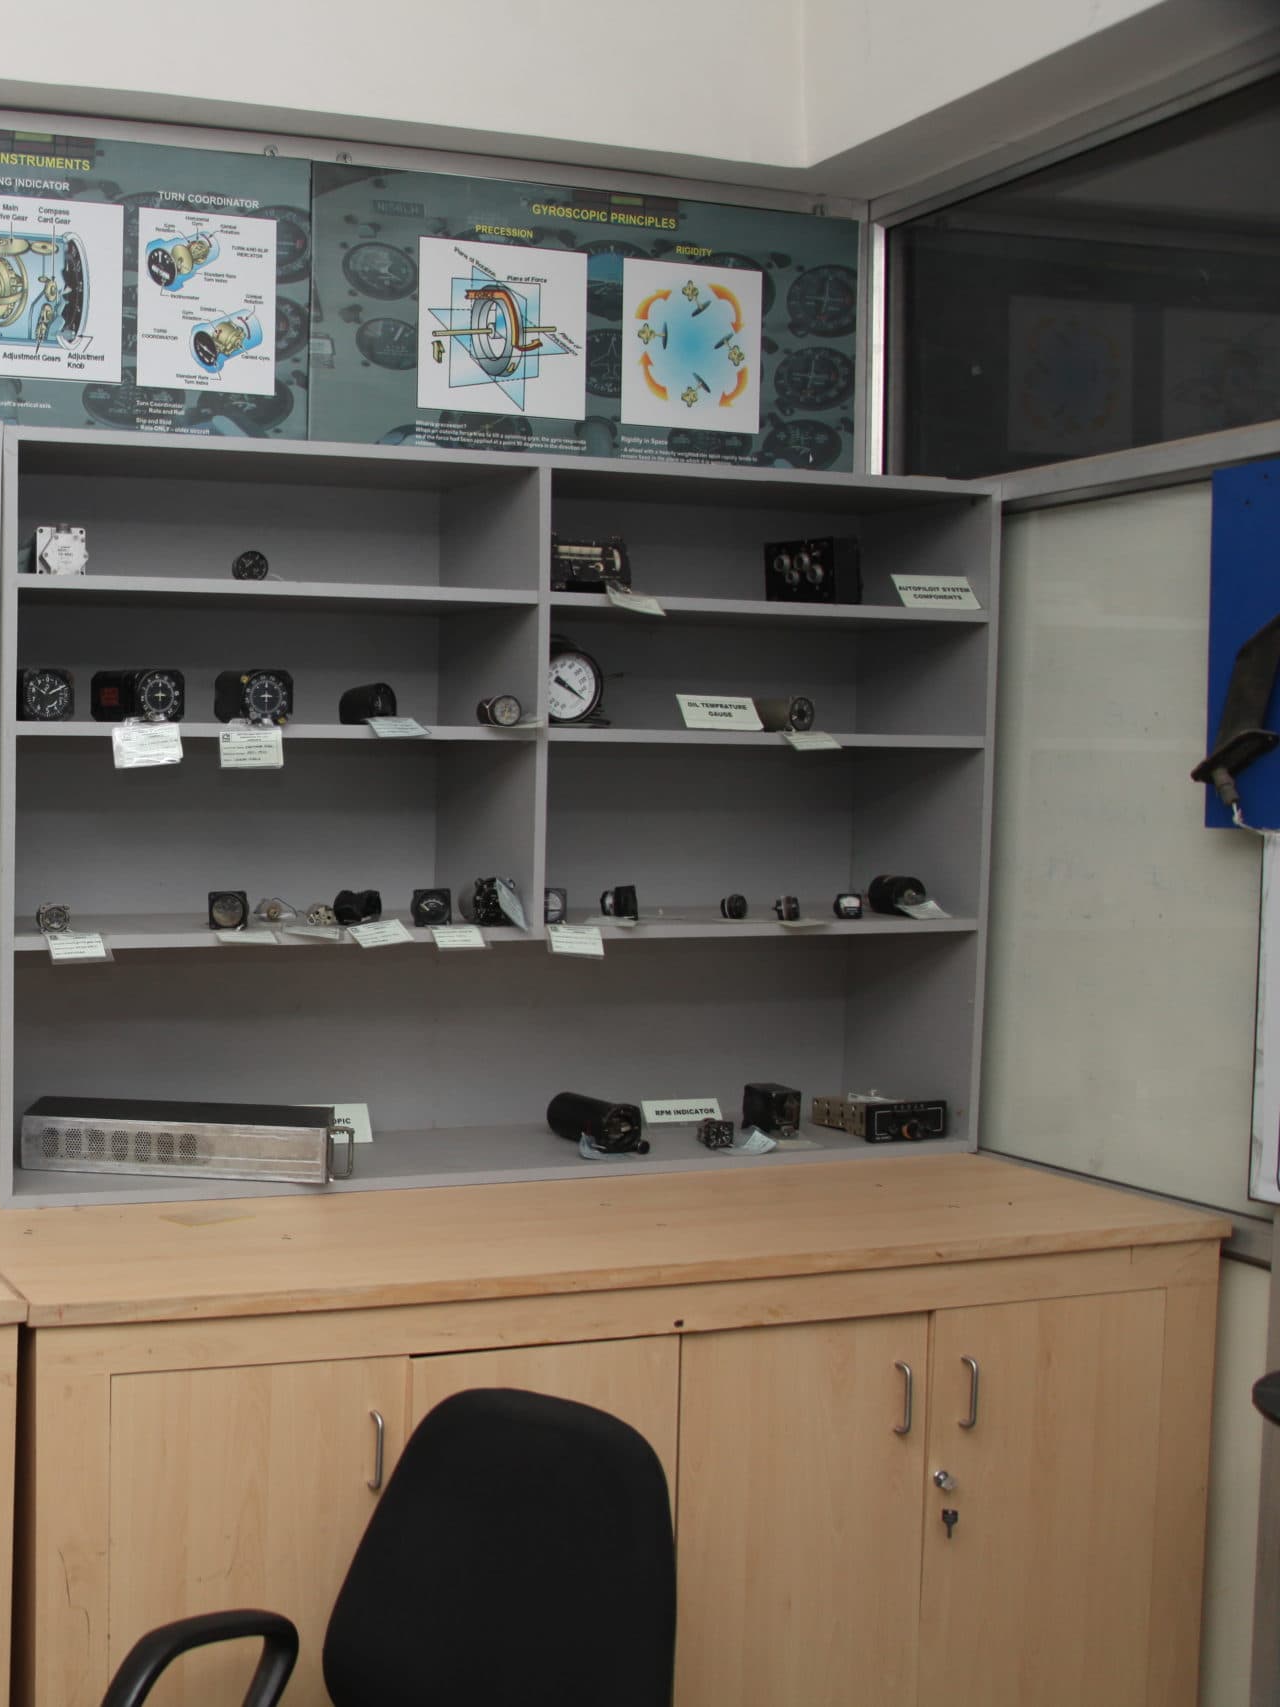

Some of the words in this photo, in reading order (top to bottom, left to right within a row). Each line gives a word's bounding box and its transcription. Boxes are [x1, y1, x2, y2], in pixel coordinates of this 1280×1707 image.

[14, 178, 70, 191] INDICATOR
[158, 190, 186, 202] TURN
[187, 193, 260, 210] COORDINATOR
[2, 203, 19, 212] Main
[38, 206, 70, 217] Compass
[11, 213, 28, 222] Gear
[37, 215, 54, 224] Card
[53, 216, 71, 226] Gear
[532, 203, 607, 223] GYROSCOPIC
[610, 211, 676, 229] PRINCIPLES
[475, 223, 534, 239] PRECESSION
[676, 245, 712, 257] RIGIDITY
[2, 352, 41, 362] Adjustment
[41, 354, 61, 363] Gears
[67, 352, 105, 362] Adjustment
[67, 362, 85, 370] Knob
[651, 438, 668, 446] Space
[941, 586, 971, 594] SYSTEM
[912, 593, 963, 601] COMPONENTS
[708, 710, 733, 718] GAUGE
[673, 1108, 716, 1116] INDICATOR
